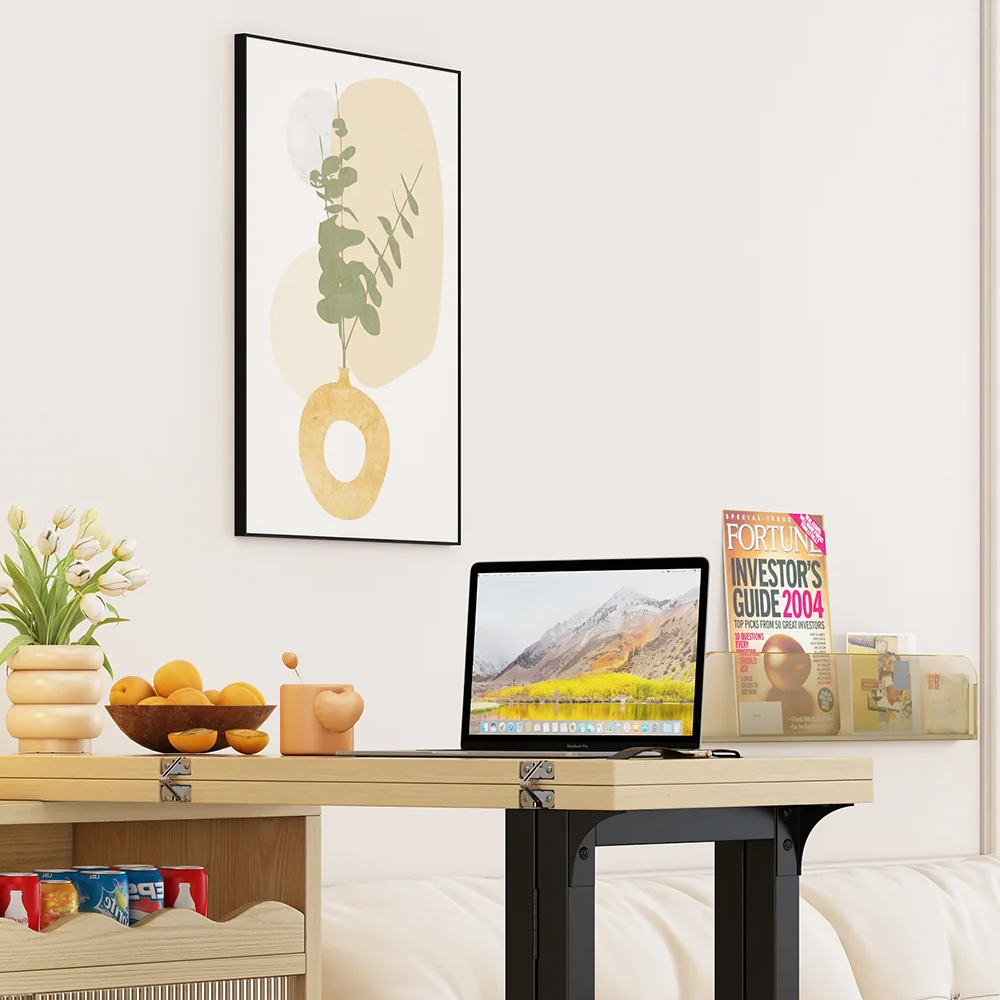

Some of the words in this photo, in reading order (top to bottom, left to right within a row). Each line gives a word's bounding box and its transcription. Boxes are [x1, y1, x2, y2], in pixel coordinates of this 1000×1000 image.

[725, 513, 761, 521] SPECIAL
[766, 515, 791, 523] ISSUE
[730, 557, 823, 589] INVESTOR'S
[733, 587, 781, 618] GUIDE
[782, 589, 825, 619] 2004
[734, 620, 744, 629] TOP
[745, 620, 759, 629] PICKS
[760, 620, 774, 629] FROM
[775, 620, 781, 629] 50
[782, 620, 797, 630] GREAT
[798, 621, 825, 630] INVESTORS
[741, 632, 764, 641] QUESTIONS
[736, 640, 749, 648] EVERY
